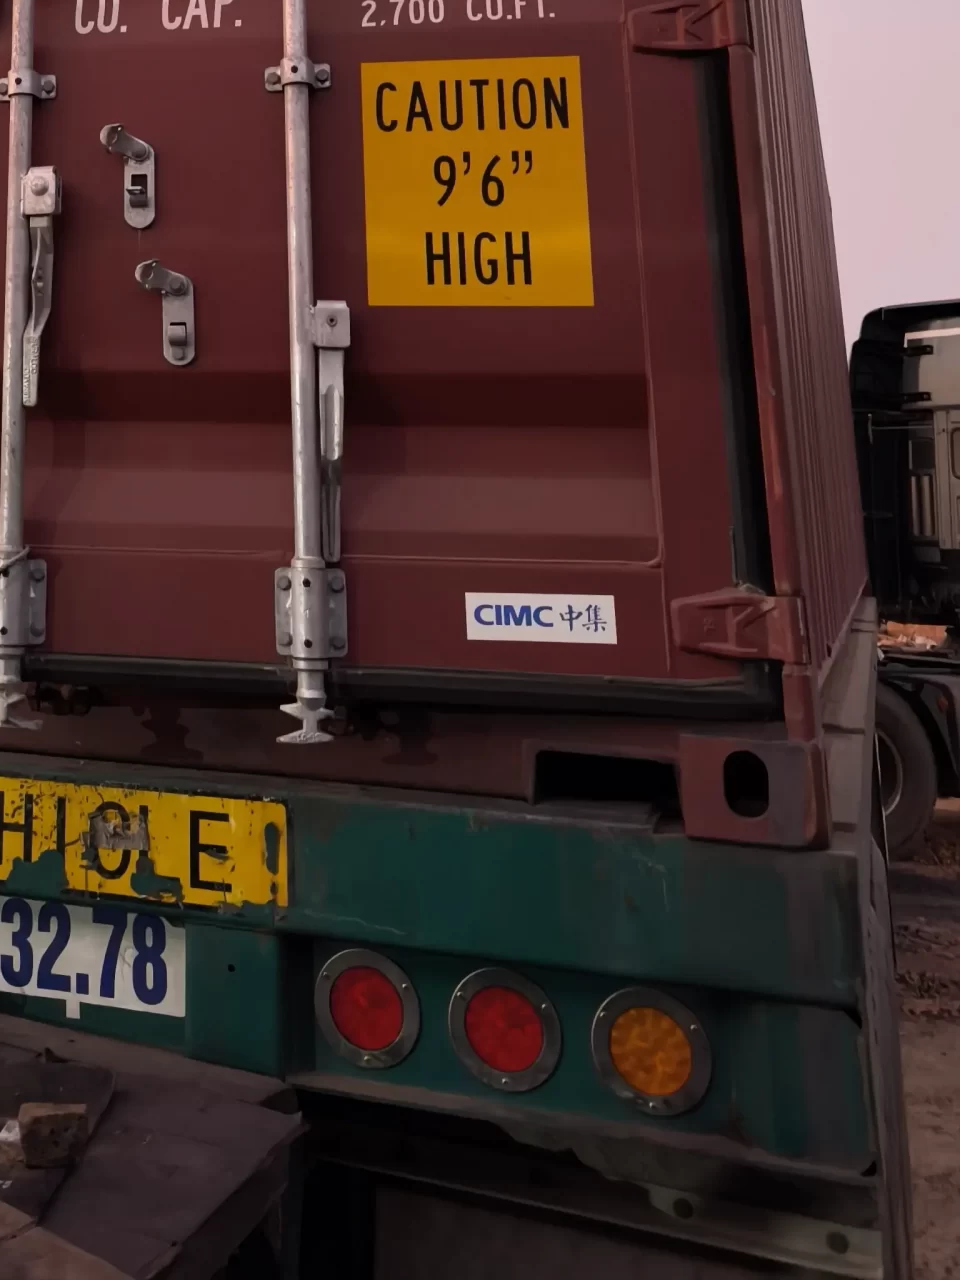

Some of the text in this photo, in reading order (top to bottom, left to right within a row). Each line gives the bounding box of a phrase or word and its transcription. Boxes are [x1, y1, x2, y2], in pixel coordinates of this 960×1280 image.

[375, 76, 570, 133] CAUTION
[425, 230, 533, 286] HIGH
[473, 603, 608, 633] CIMC 中集
